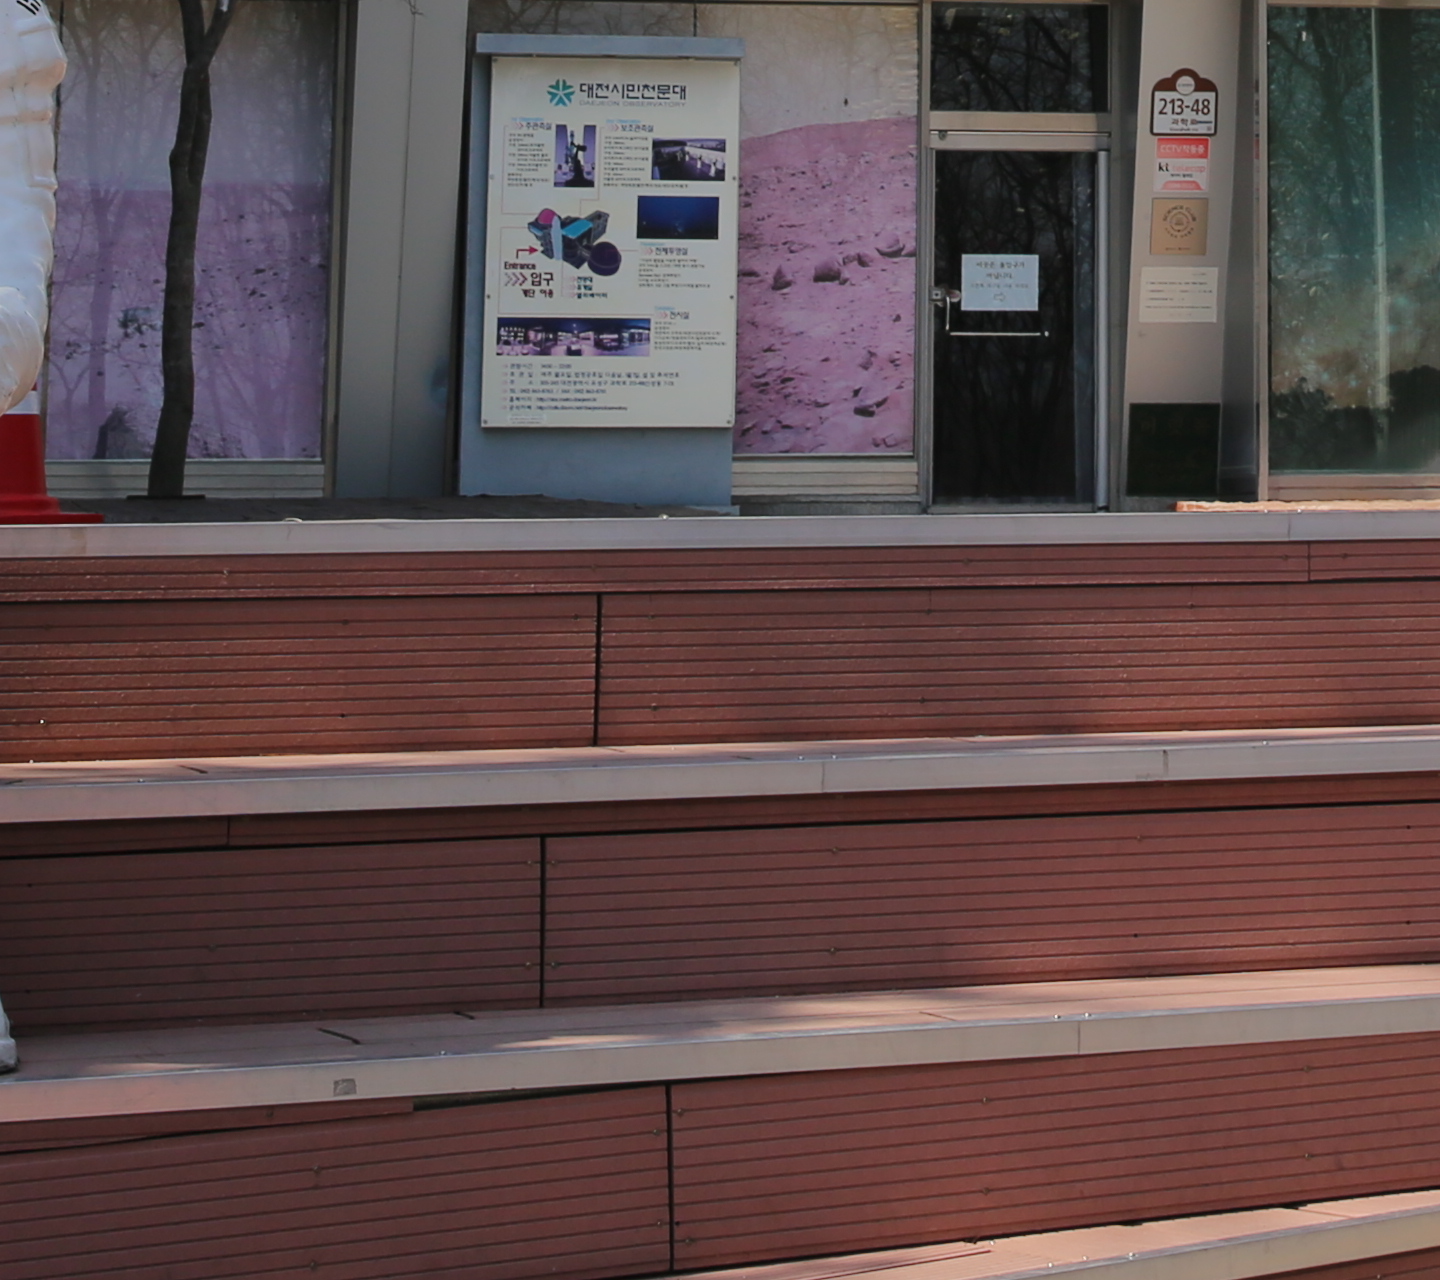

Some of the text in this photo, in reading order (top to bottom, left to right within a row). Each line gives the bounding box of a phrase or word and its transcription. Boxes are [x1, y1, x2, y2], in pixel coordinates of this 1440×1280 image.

[579, 82, 687, 101] 대전시민천문대
[623, 100, 687, 108] OBSERVATORY
[1158, 97, 1211, 116] 213-48
[504, 261, 536, 270] Entrance
[530, 272, 555, 287] 입구
